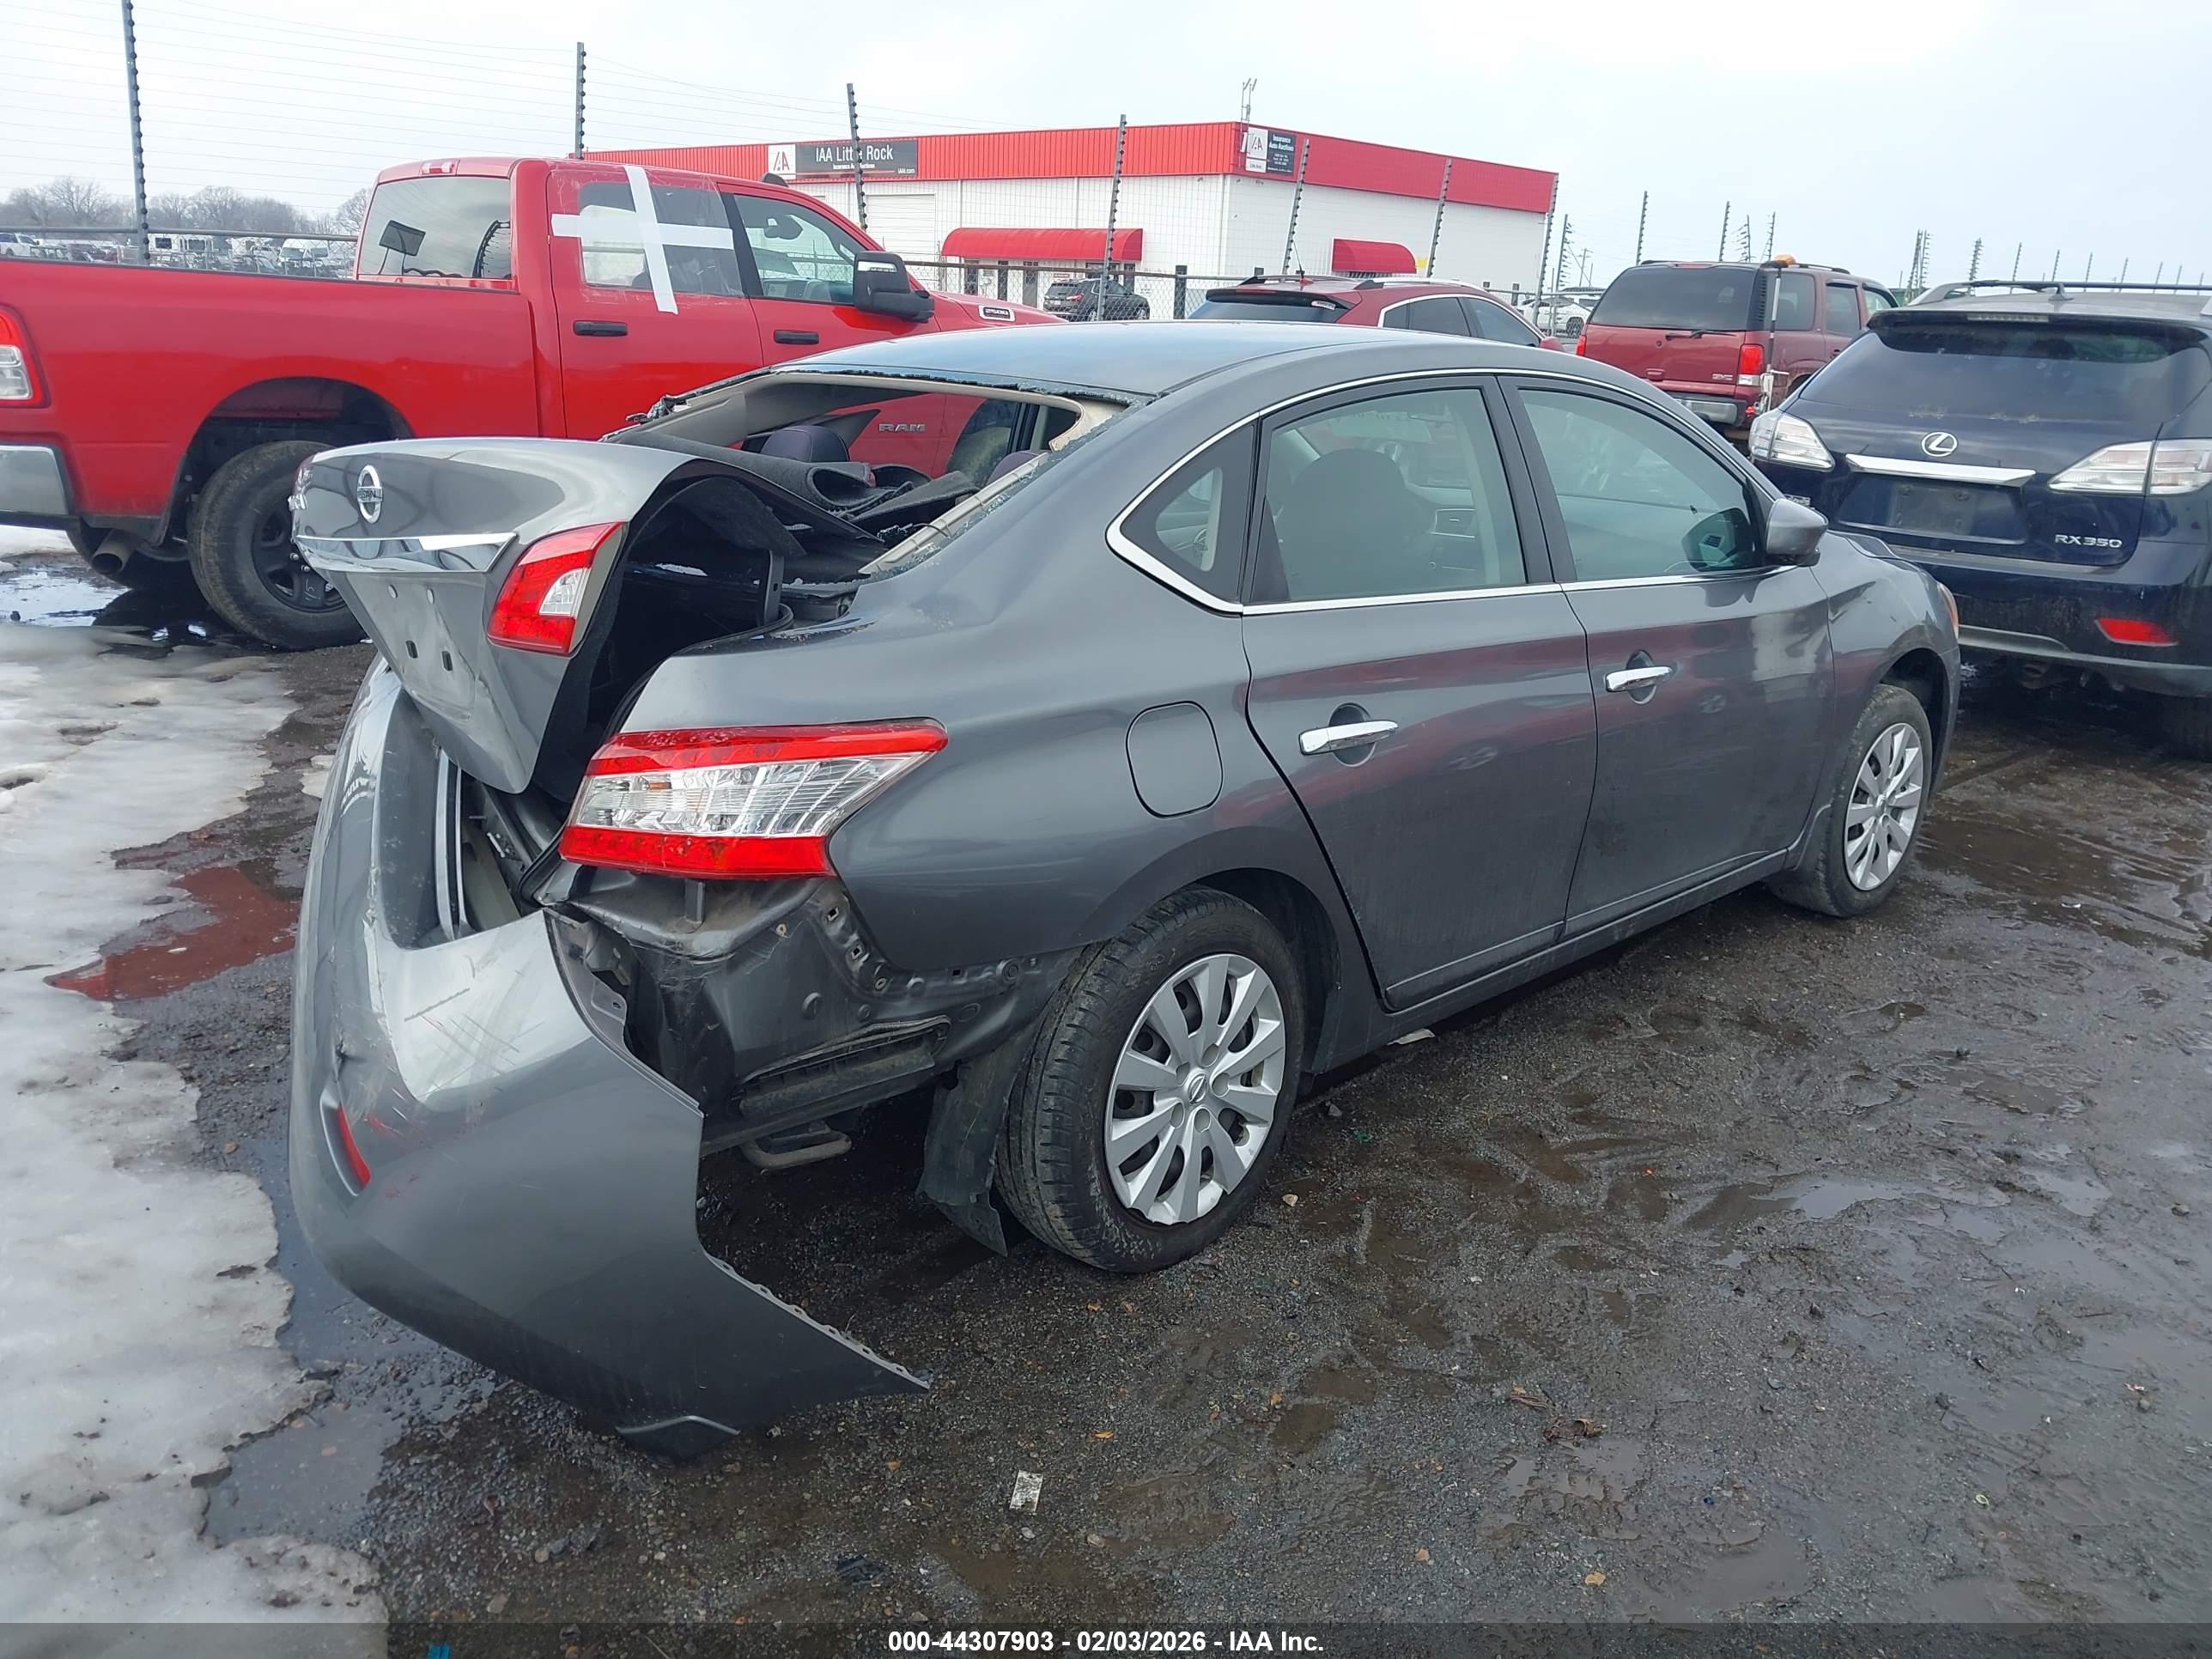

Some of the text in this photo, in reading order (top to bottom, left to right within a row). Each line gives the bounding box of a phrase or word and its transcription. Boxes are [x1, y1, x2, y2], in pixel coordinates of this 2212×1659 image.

[816, 144, 894, 162] IAA Litte Rock
[878, 423, 926, 432] RAM
